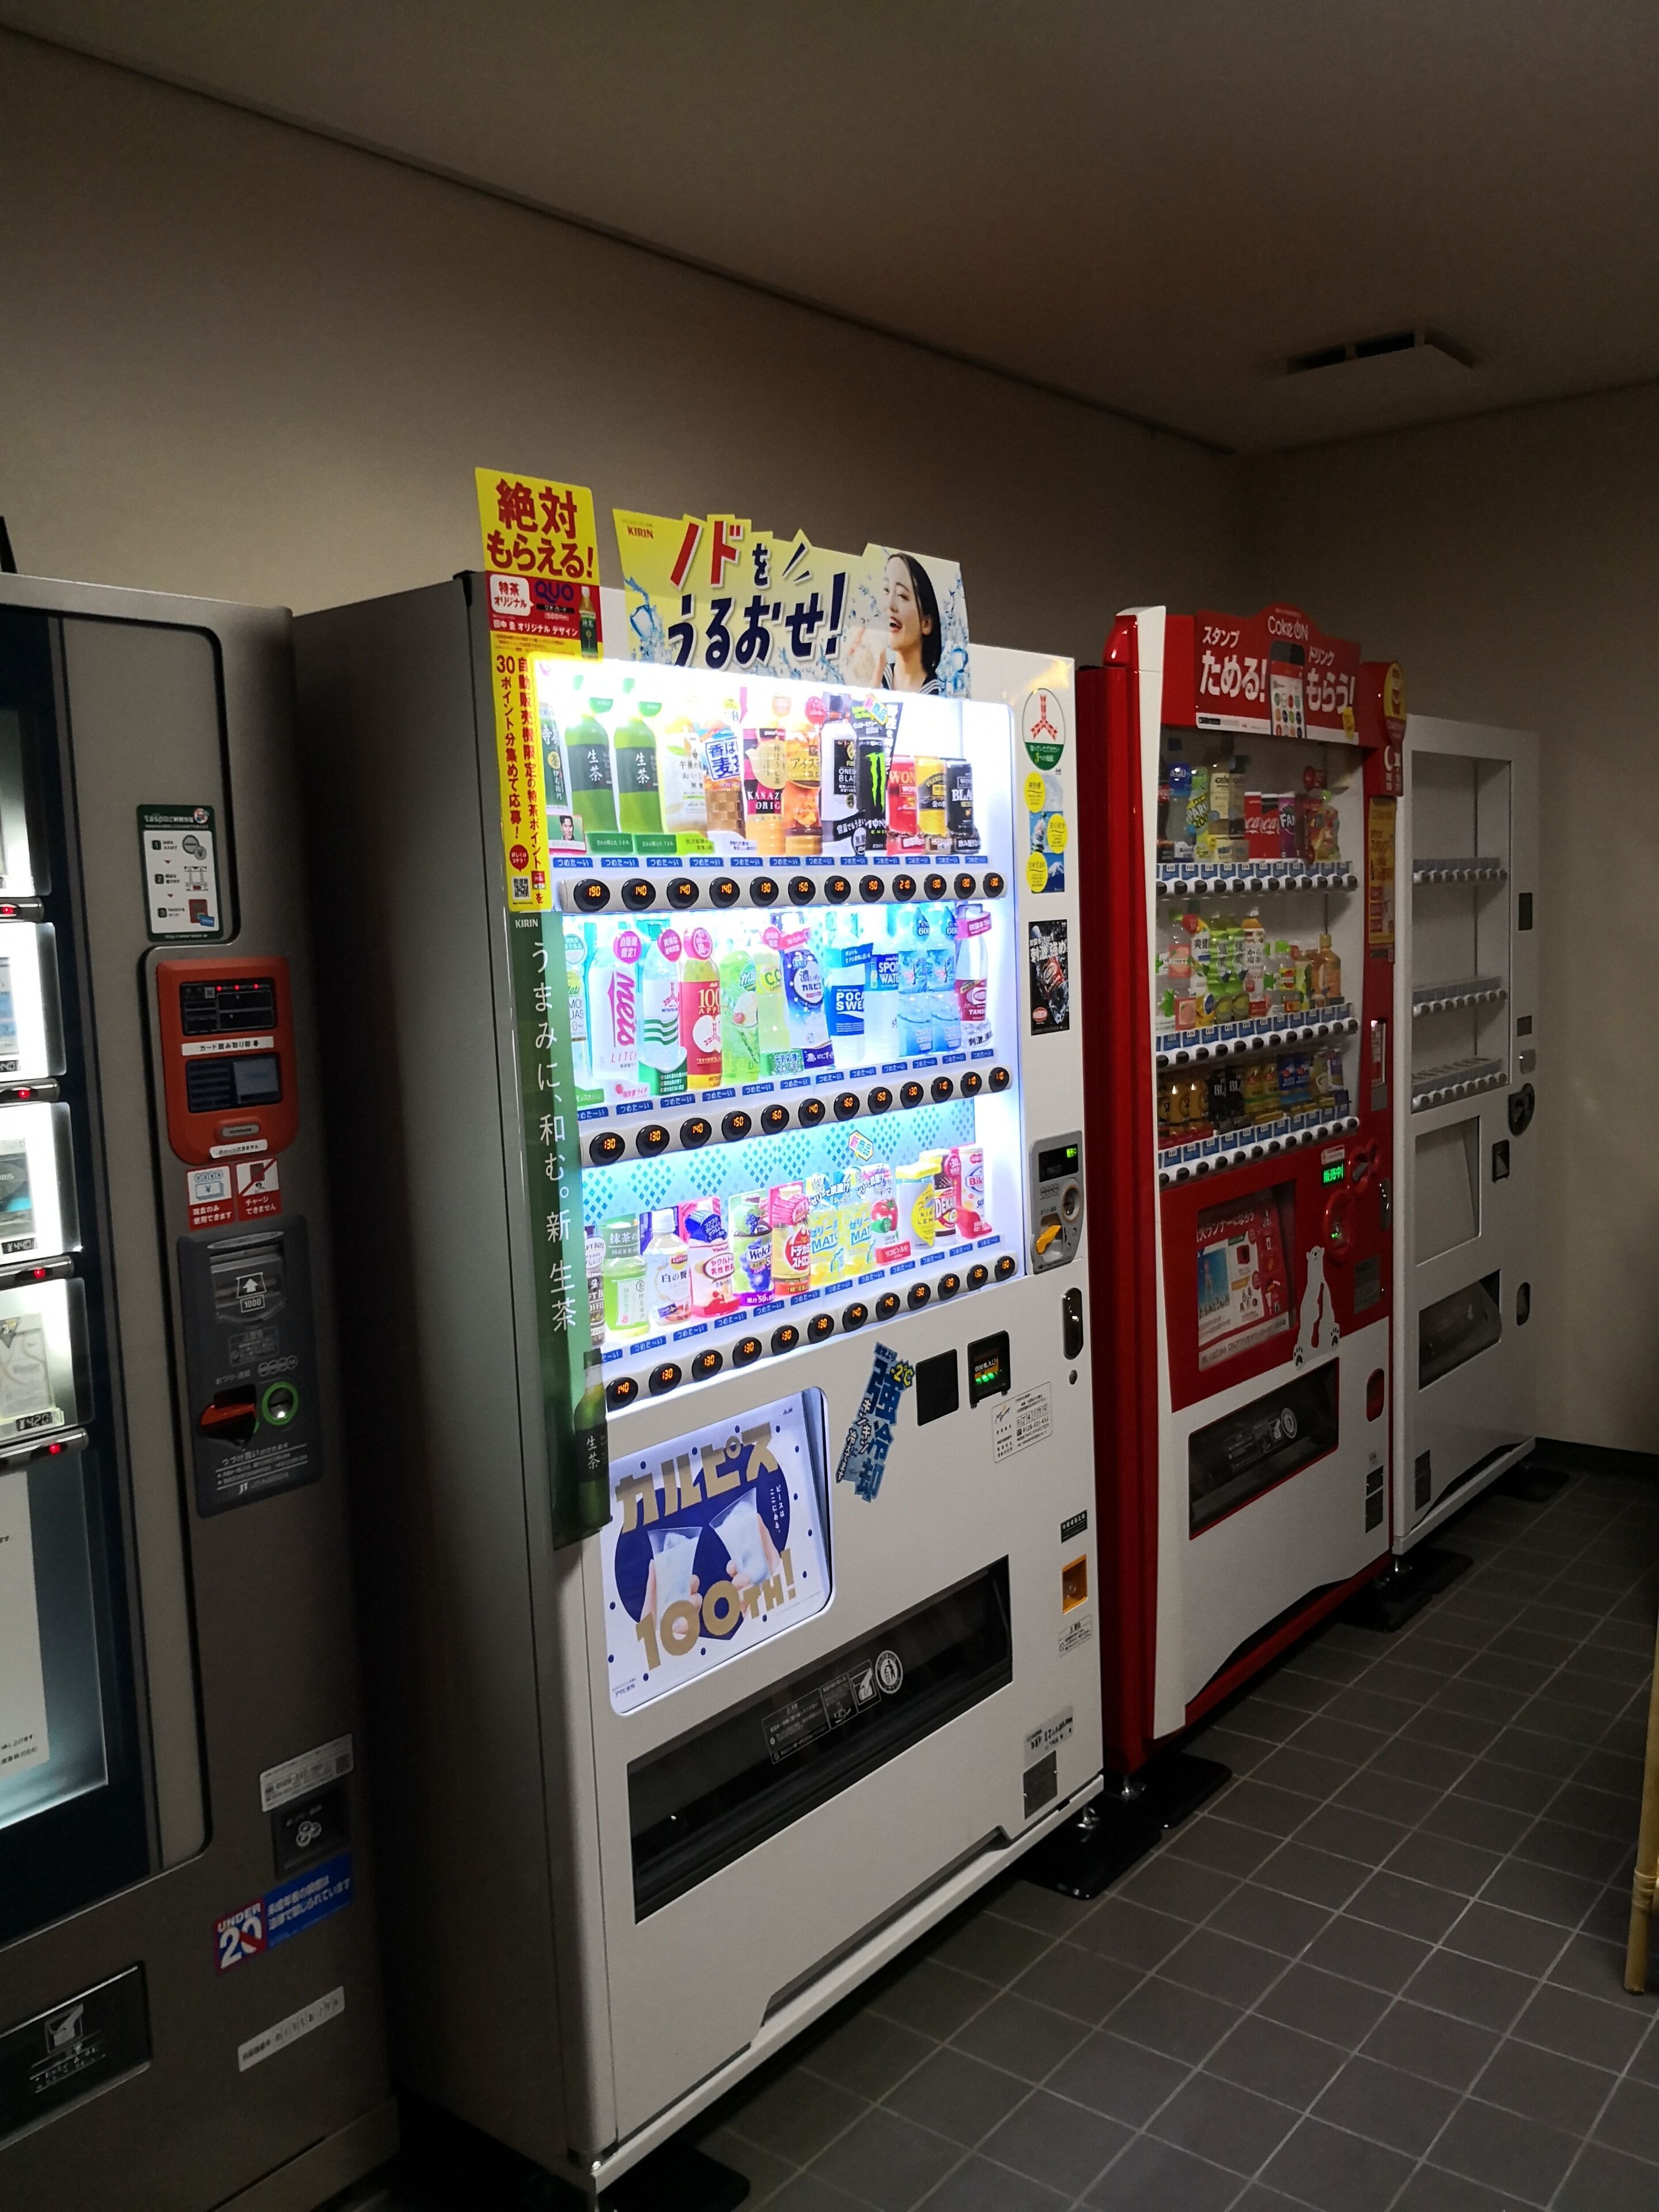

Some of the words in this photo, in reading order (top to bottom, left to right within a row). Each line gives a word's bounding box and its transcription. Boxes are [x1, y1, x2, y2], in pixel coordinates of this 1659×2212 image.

[495, 478, 577, 539] 絶対
[627, 526, 653, 539] KIRIN
[487, 529, 593, 578] もらえる!
[499, 582, 519, 596] 特茶
[535, 581, 574, 604] QUO
[494, 596, 528, 609] オリジナル
[667, 571, 848, 670] うるおせ!
[518, 621, 551, 634] オリジナル
[552, 625, 578, 637] デザイン
[1202, 626, 1240, 648] スタンプ
[1309, 646, 1335, 666] ドリンク
[1200, 650, 1267, 703] ためる!
[1306, 668, 1355, 714] もらう!
[587, 749, 603, 781] 生茶
[635, 752, 650, 784] 生茶
[589, 886, 601, 896] 190
[636, 885, 647, 896] 140
[680, 884, 690, 895] 140
[722, 883, 732, 893] 140
[762, 882, 771, 893] 130
[799, 882, 808, 892] 150
[515, 919, 538, 928] KIRIN
[809, 1104, 818, 1113] 140
[772, 1110, 782, 1120] 160
[734, 1116, 744, 1127] 150
[693, 1123, 703, 1133] 140
[650, 1130, 661, 1141] 130
[604, 1138, 615, 1150] 130
[246, 1196, 269, 1206] チャージ
[246, 1203, 276, 1215] できません
[244, 1298, 262, 1308] 1000
[818, 1318, 827, 1329] 130
[782, 1330, 791, 1340] 130
[744, 1342, 754, 1353] 130
[704, 1354, 714, 1366] 130
[662, 1368, 673, 1380] 130
[618, 1382, 629, 1394] 140
[586, 1435, 600, 1469] 生茶
[615, 1422, 780, 1534] カルピス
[775, 1484, 785, 1518] ピースは
[770, 1488, 781, 1533] ここにある。
[218, 1902, 262, 1933] UNDER
[219, 1914, 264, 1970] 20
